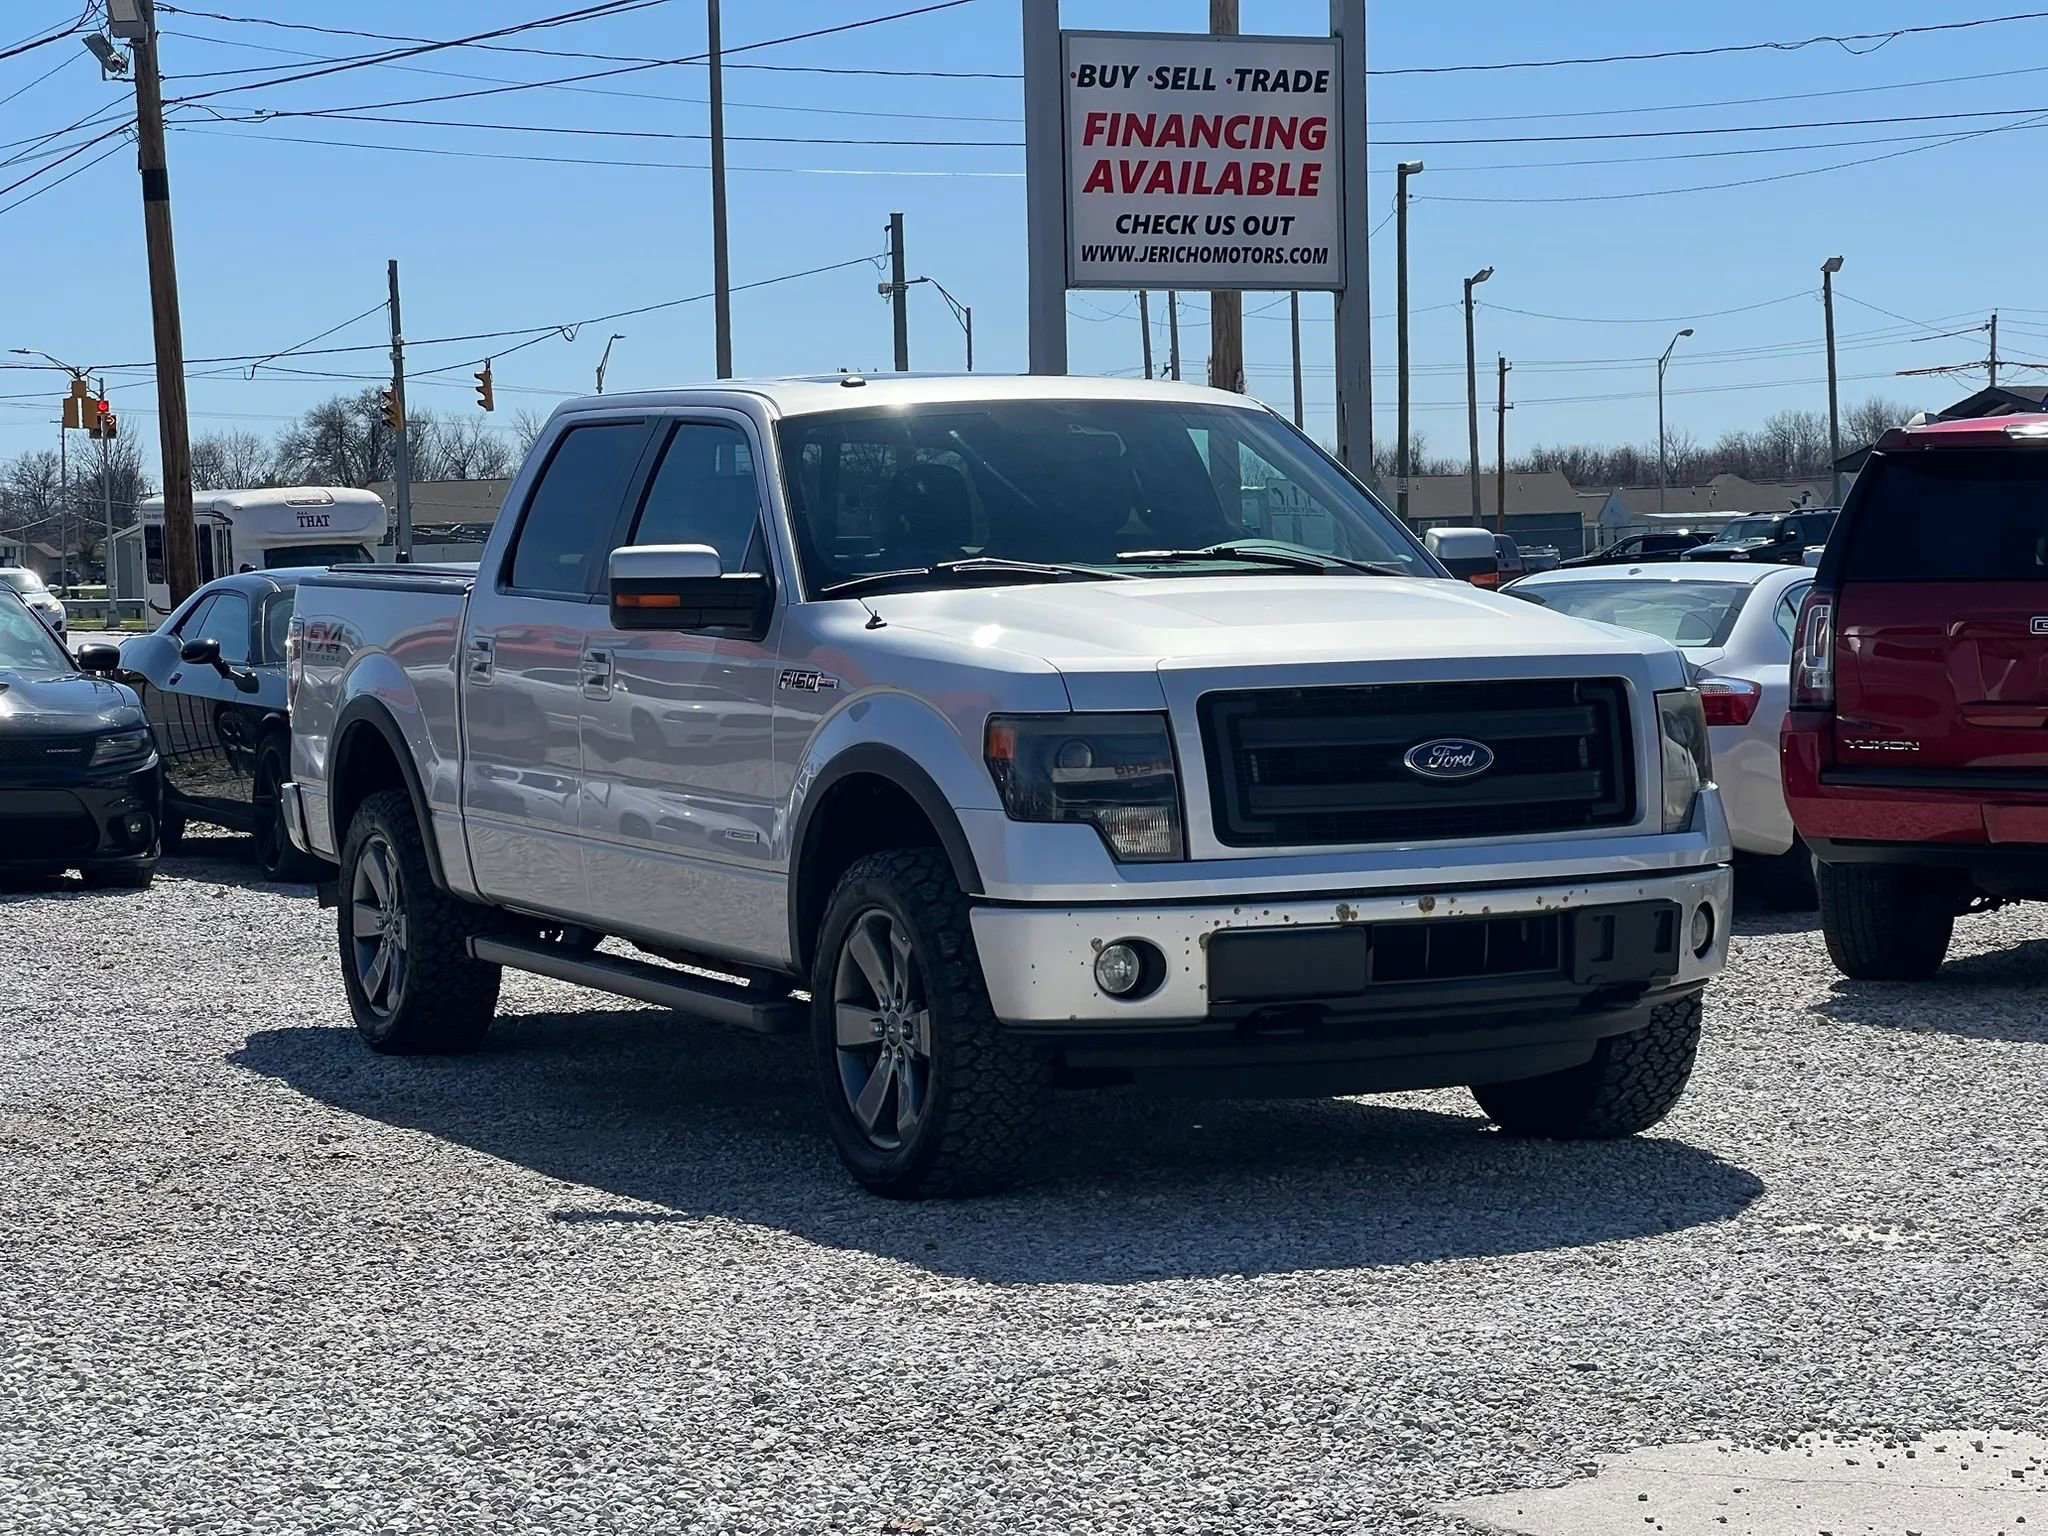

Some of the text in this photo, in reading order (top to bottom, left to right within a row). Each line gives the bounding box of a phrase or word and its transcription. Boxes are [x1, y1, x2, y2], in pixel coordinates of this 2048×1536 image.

[1082, 111, 1328, 150] FINANCING
[1082, 159, 1322, 197] AVAILABLE
[1115, 213, 1296, 236] CHECK US OUT
[1081, 244, 1329, 265] WWW.JERICHOMOTORS.COM
[296, 514, 330, 528] THAT
[1424, 744, 1476, 769] Ford
[1843, 739, 1920, 751] YUKON
